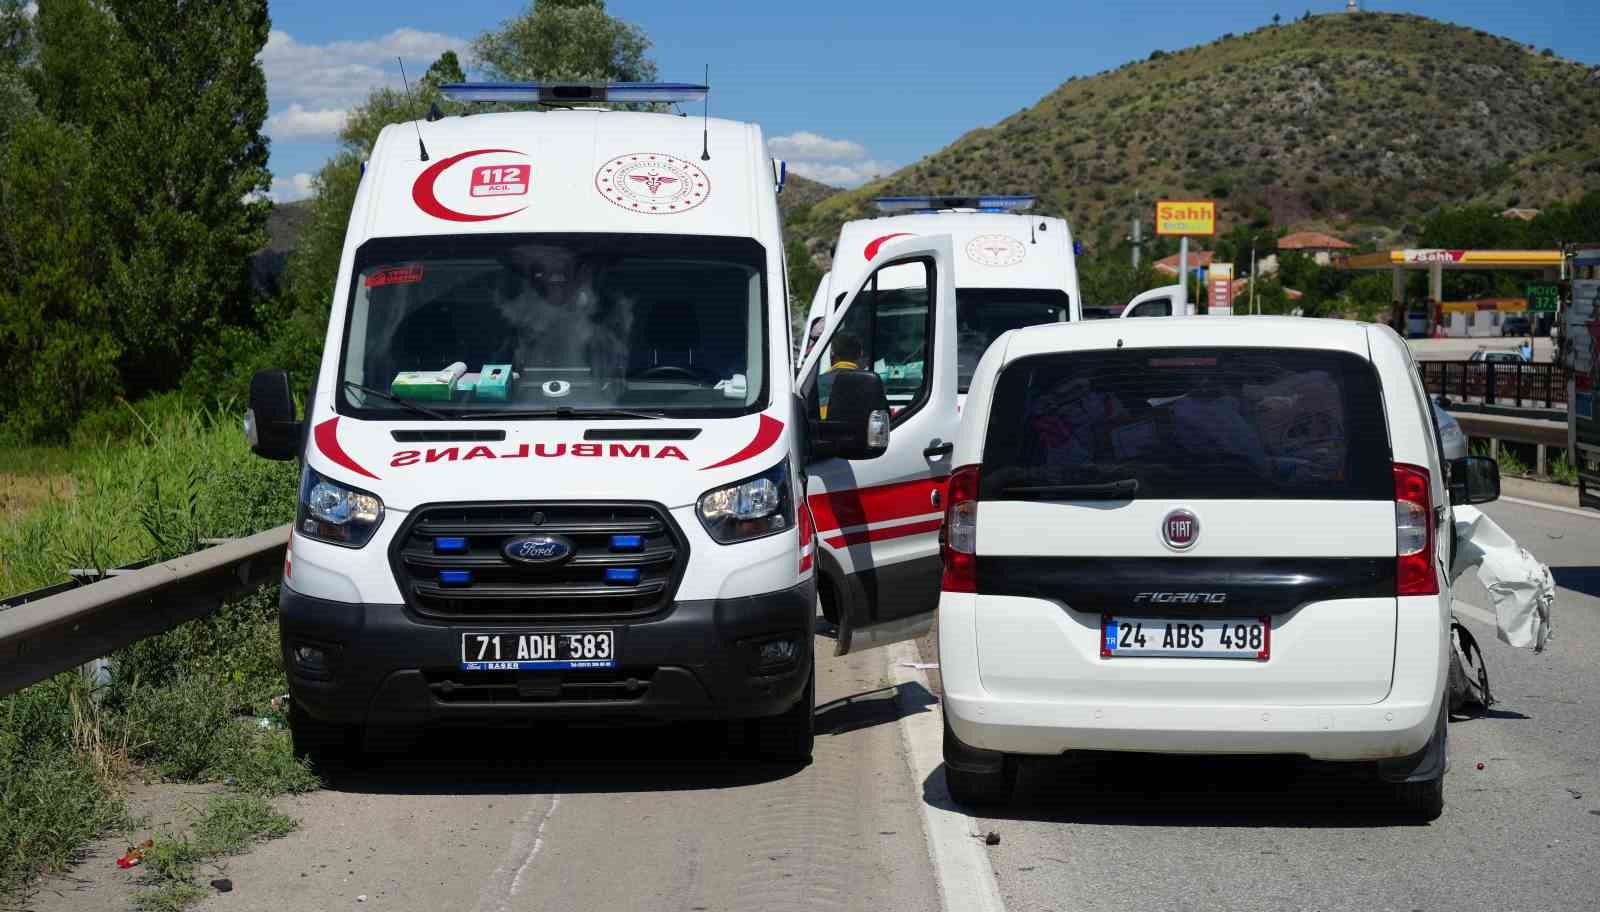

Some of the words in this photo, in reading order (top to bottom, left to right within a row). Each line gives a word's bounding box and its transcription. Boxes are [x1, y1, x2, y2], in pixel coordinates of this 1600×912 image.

[481, 168, 521, 184] 112
[1160, 206, 1213, 222] Sahh
[1417, 250, 1453, 262] Sahh
[1170, 520, 1192, 537] FIAT
[519, 541, 556, 556] Ford
[1133, 592, 1227, 604] FIORINO
[1119, 622, 1147, 649] 24
[1162, 622, 1205, 650] ABS
[1219, 623, 1263, 651] 498
[477, 635, 501, 660] 71
[517, 635, 556, 659] ADH
[570, 634, 609, 658] 583
